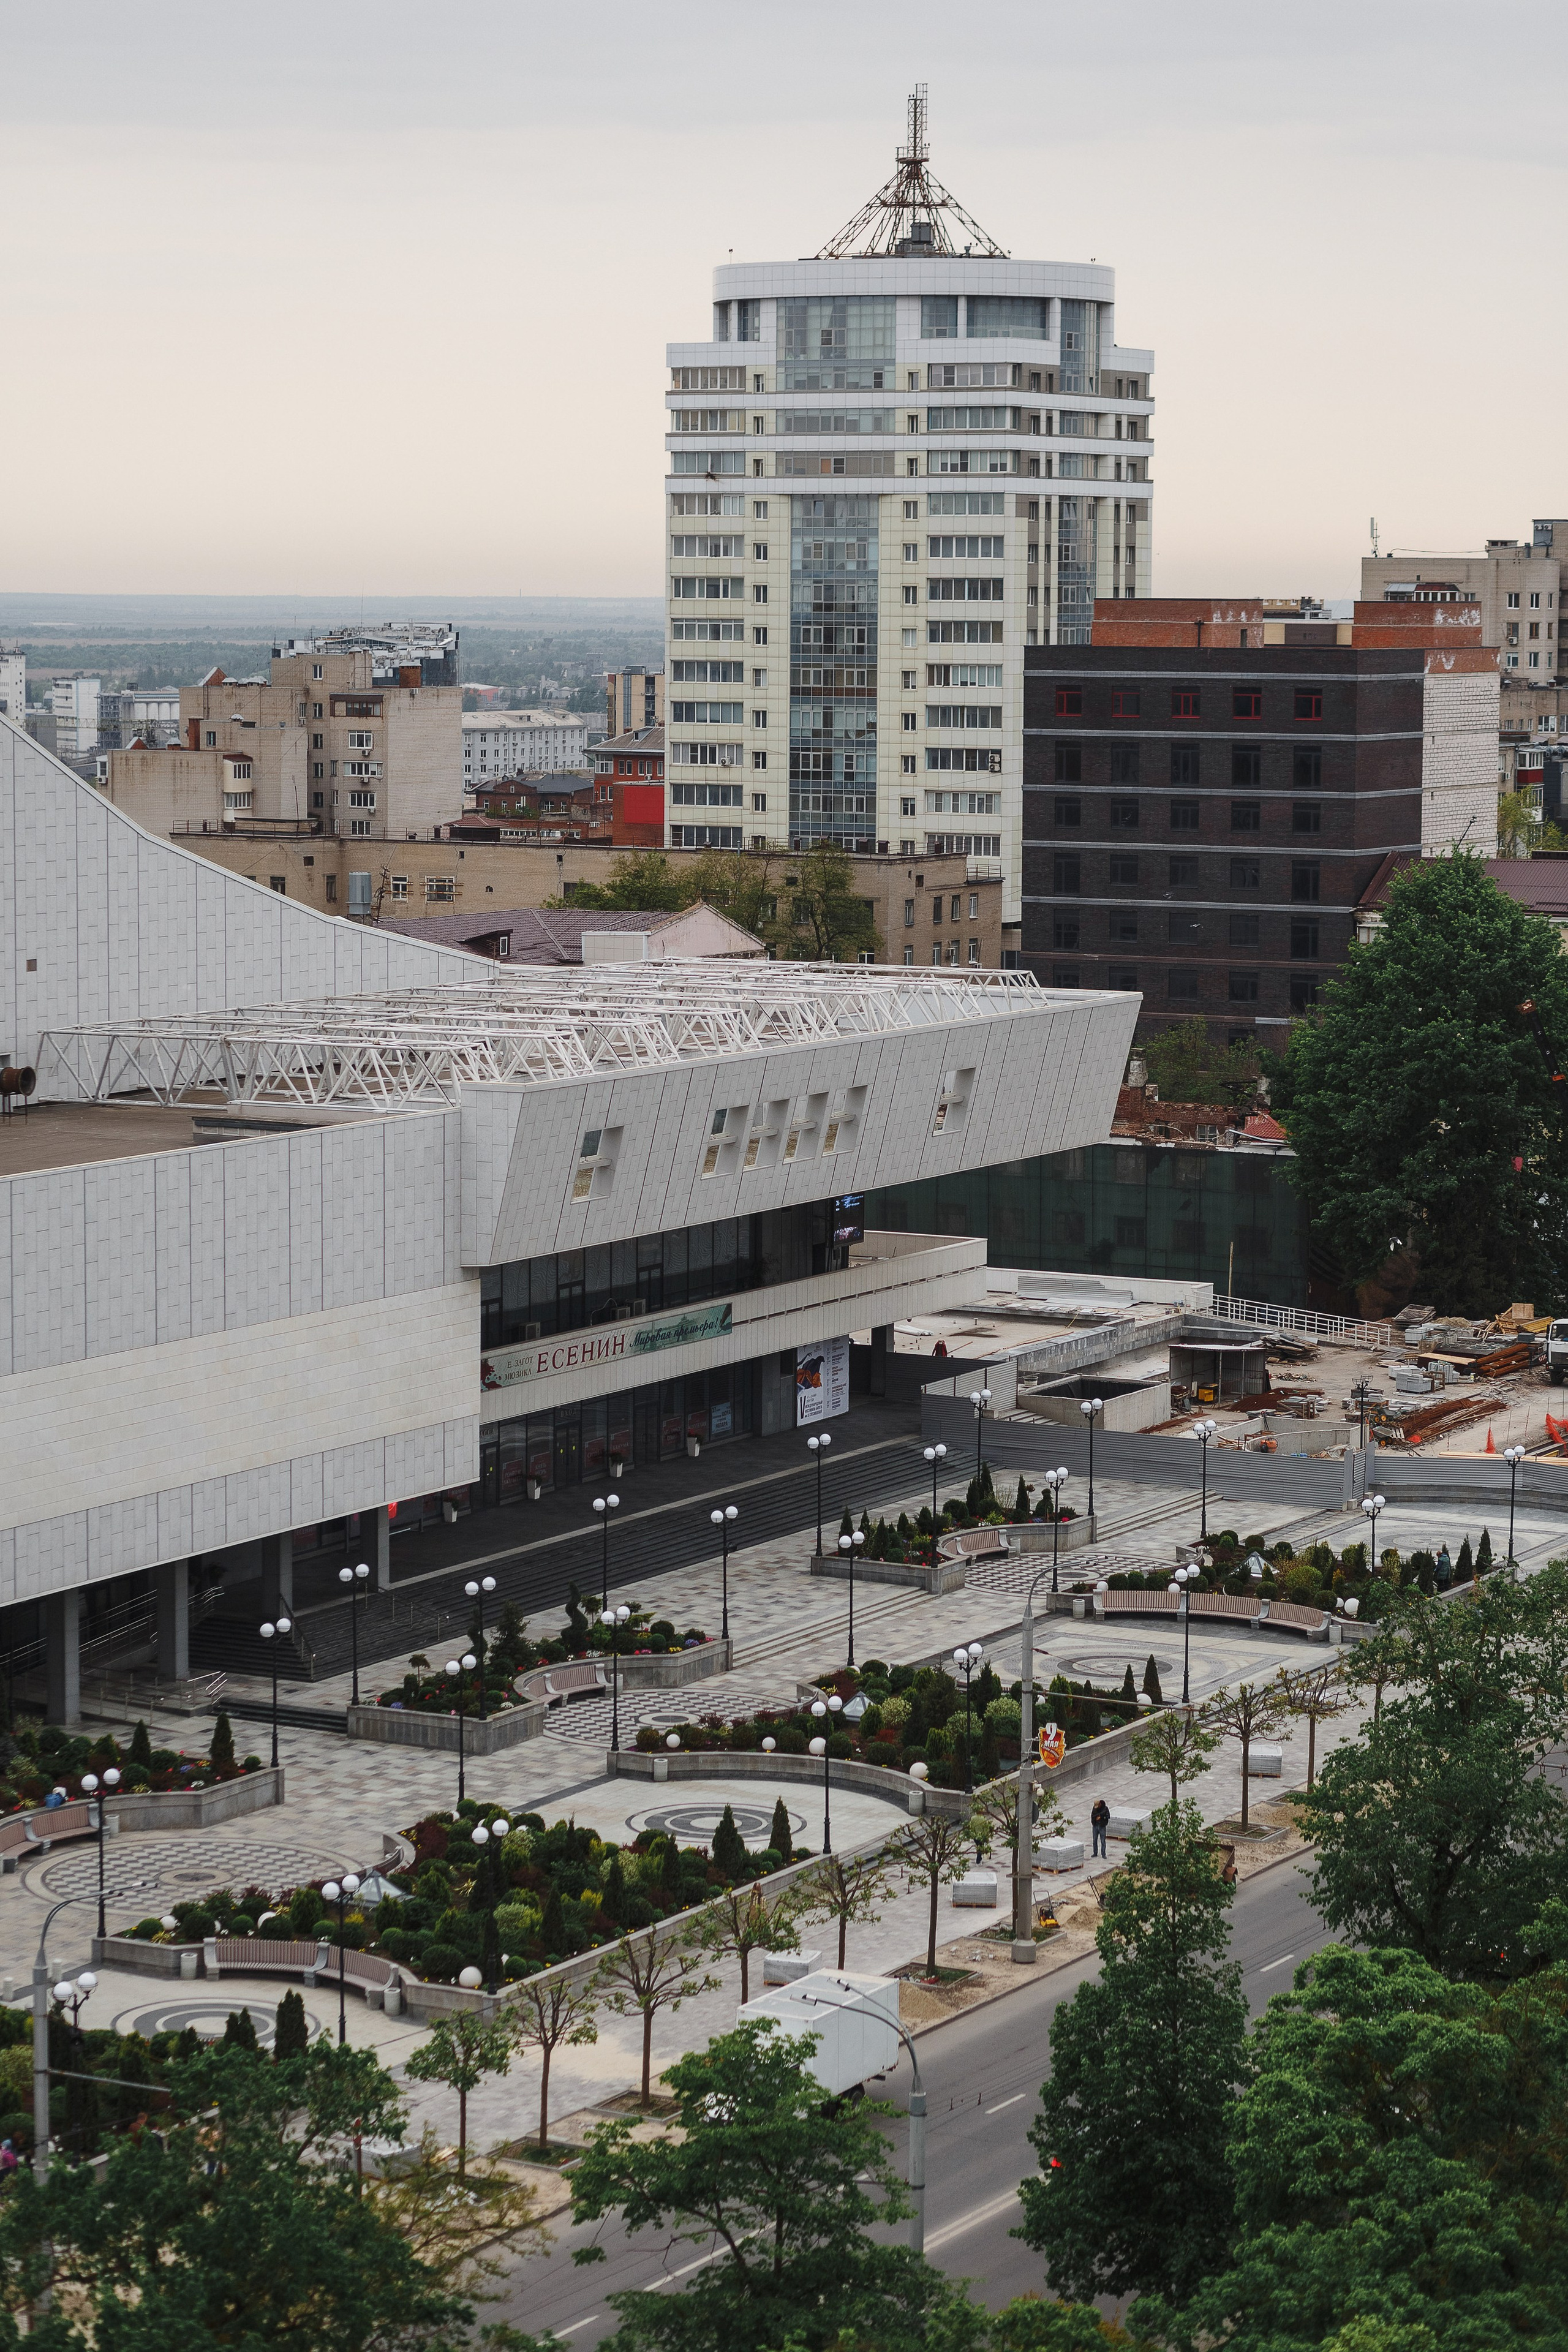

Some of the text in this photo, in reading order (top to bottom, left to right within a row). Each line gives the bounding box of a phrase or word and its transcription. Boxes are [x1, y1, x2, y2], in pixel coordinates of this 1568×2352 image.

[630, 1317, 718, 1350] Мировая премьера!
[536, 1333, 625, 1374] ЕСЕНИН
[514, 1355, 533, 1368] ЗАГОТ
[504, 1368, 532, 1381] МЮЗИКЛ
[560, 1409, 576, 1417] ВХОД
[480, 1428, 496, 1437] АССА
[1046, 1722, 1057, 1741] 9
[1044, 1740, 1058, 1748] МАЯ
